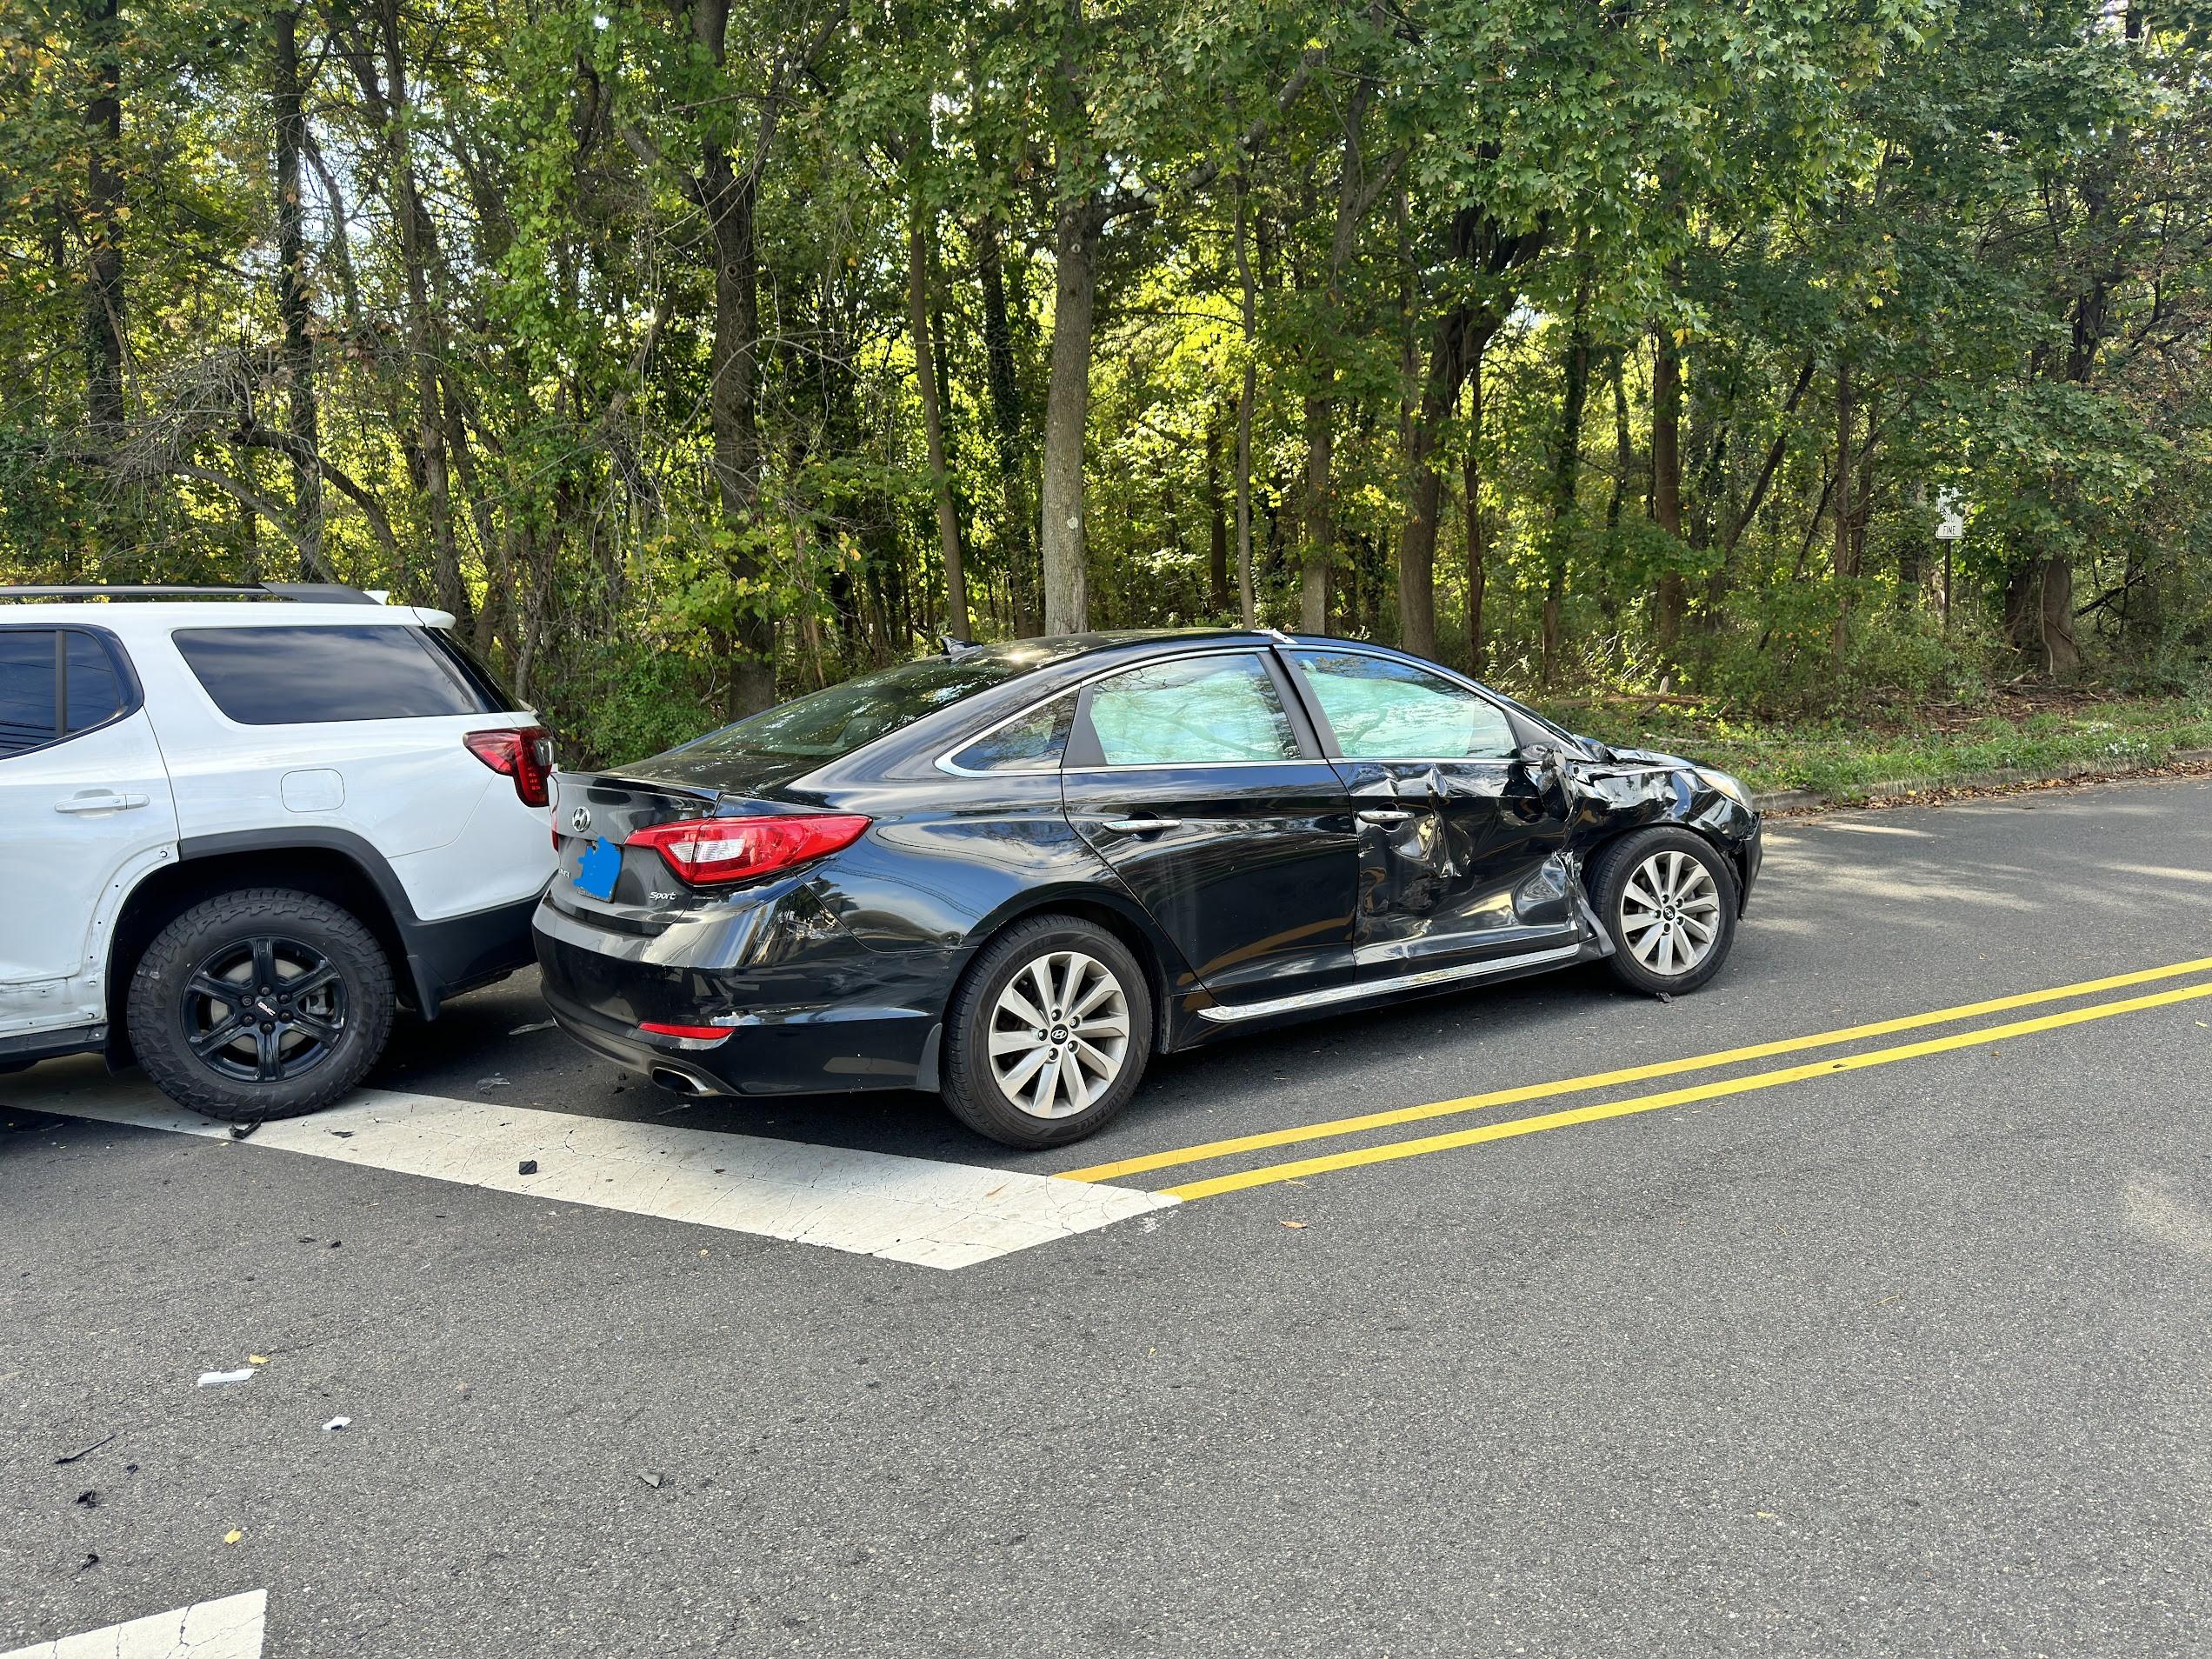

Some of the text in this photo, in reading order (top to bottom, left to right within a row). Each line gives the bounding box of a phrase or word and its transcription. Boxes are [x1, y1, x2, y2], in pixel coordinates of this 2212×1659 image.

[1943, 525, 1955, 536] FINE
[648, 891, 676, 901] Sport
[257, 1002, 276, 1016] GMC
